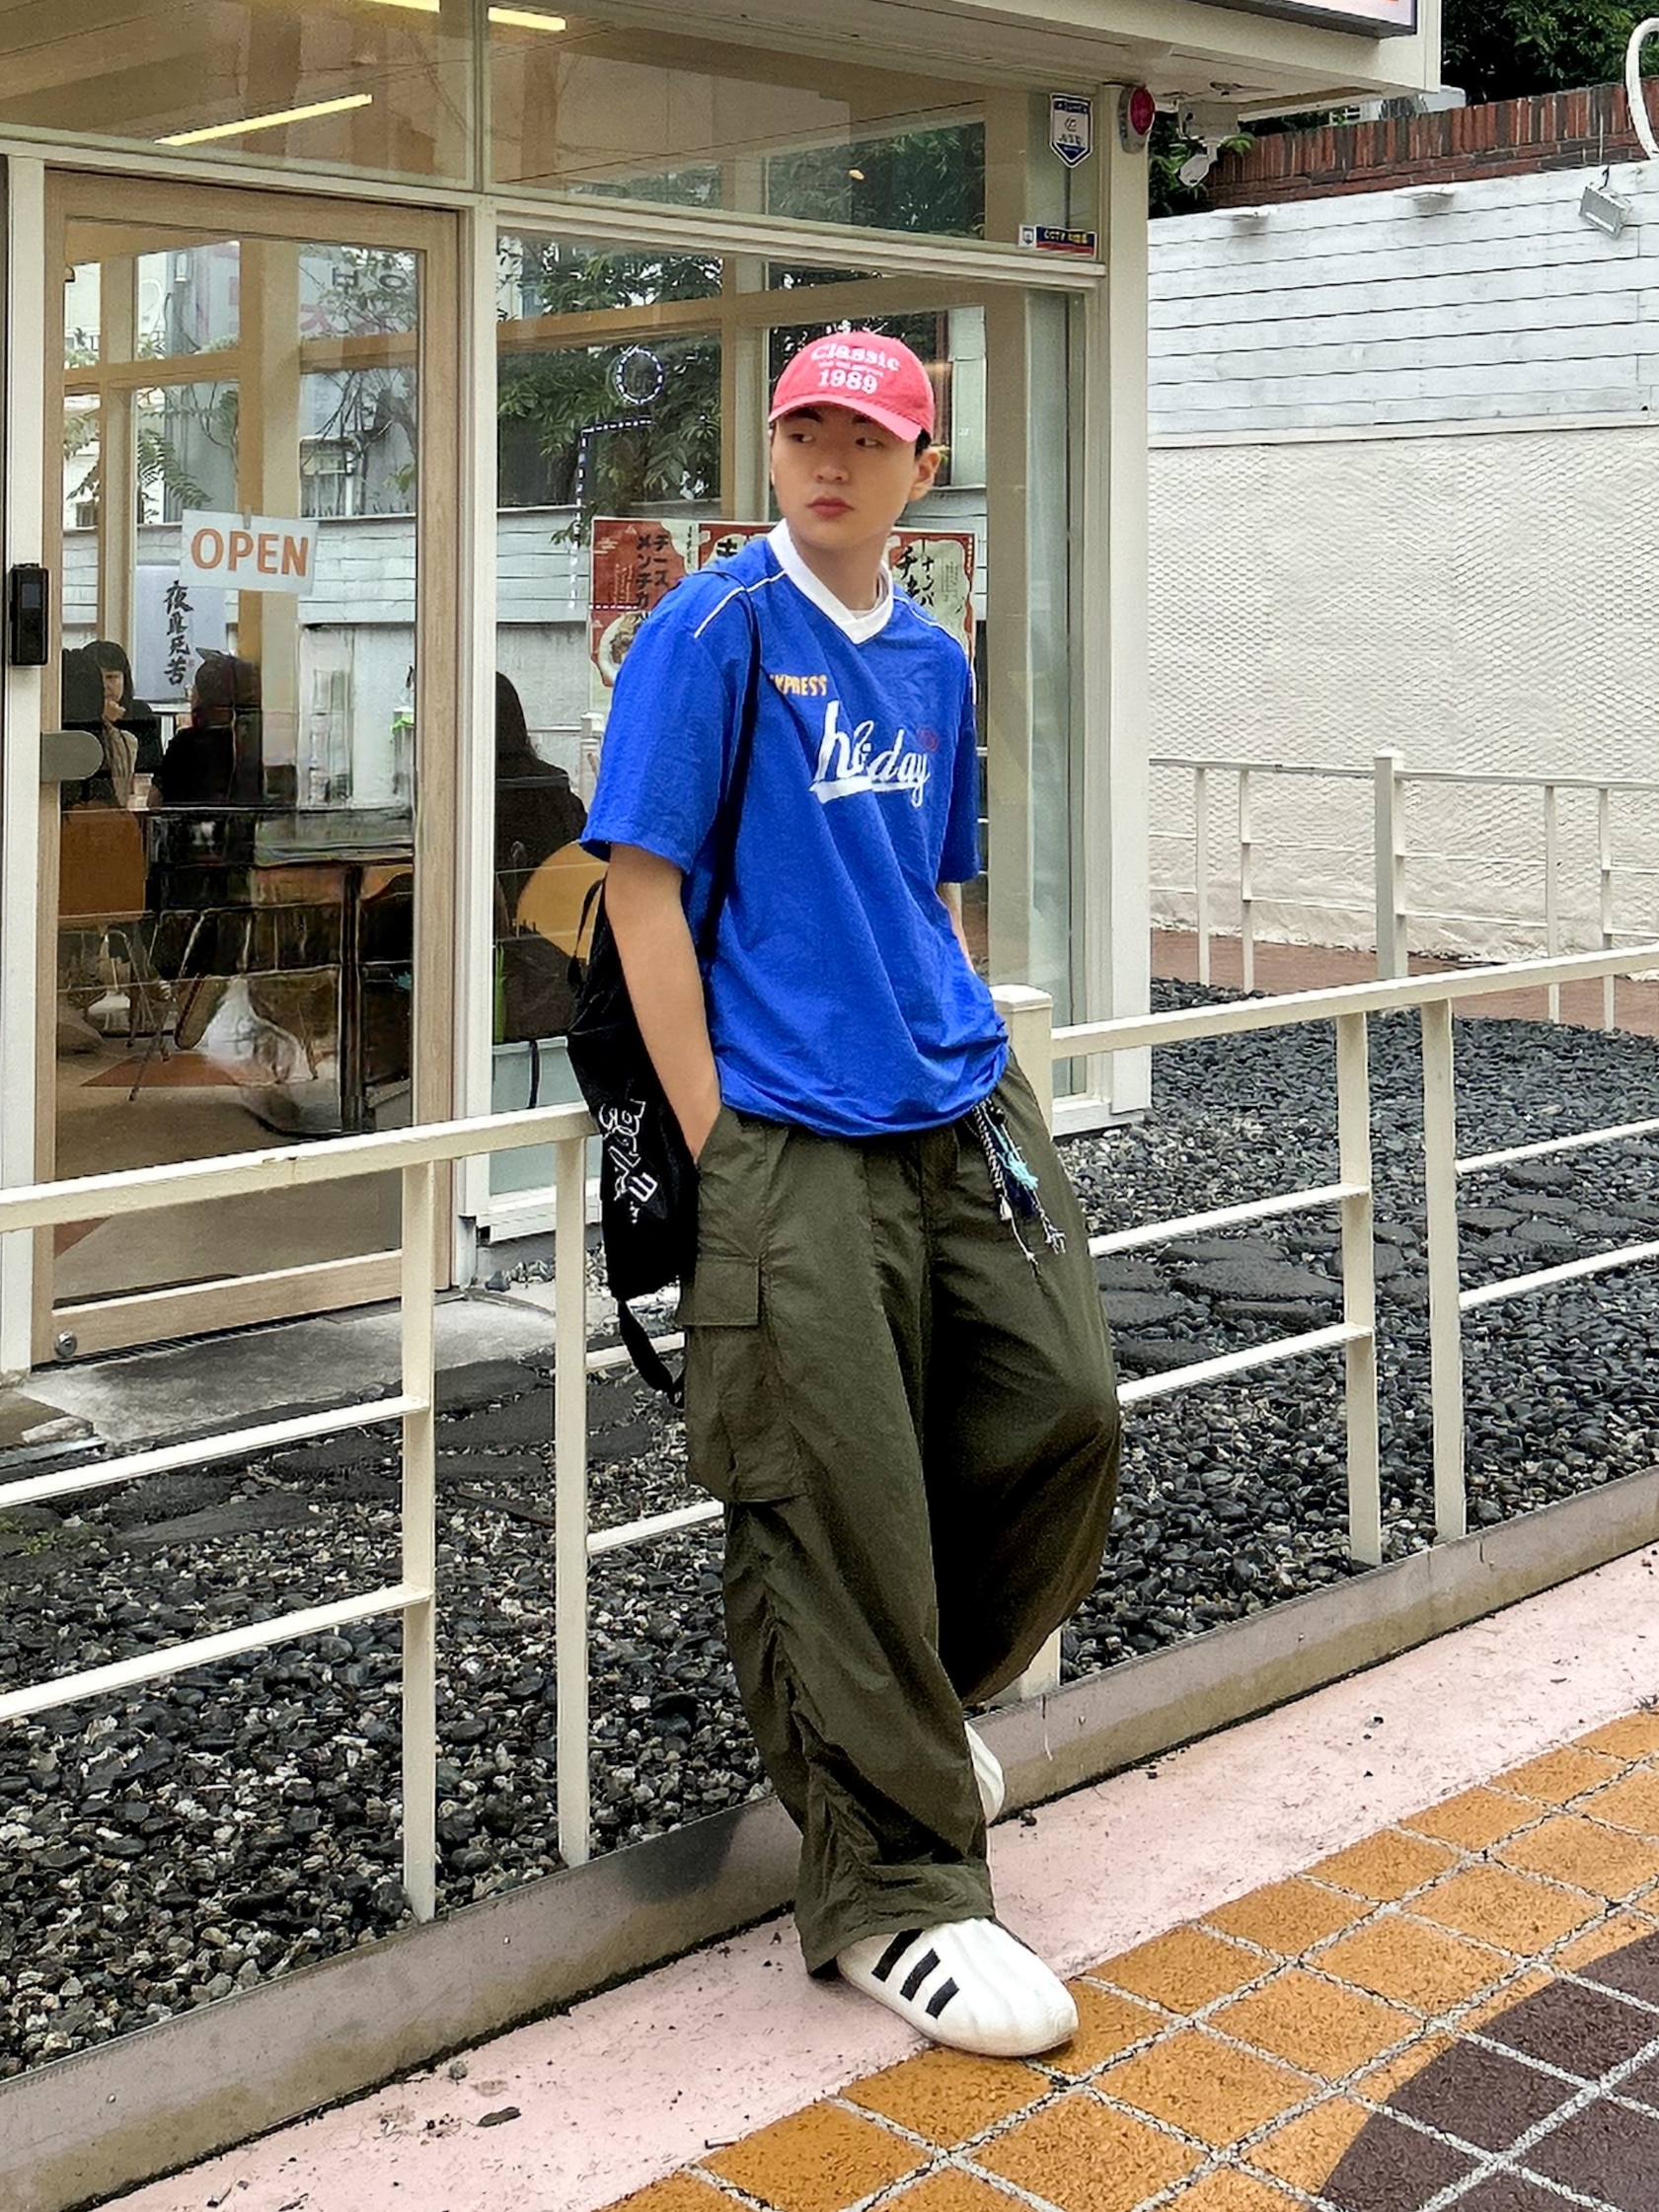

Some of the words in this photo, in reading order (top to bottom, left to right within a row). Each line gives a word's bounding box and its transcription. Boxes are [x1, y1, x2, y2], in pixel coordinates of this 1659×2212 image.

[810, 342, 900, 372] Classic
[817, 369, 878, 395] 1989
[190, 528, 309, 577] OPEN
[769, 674, 828, 697] XPRESS
